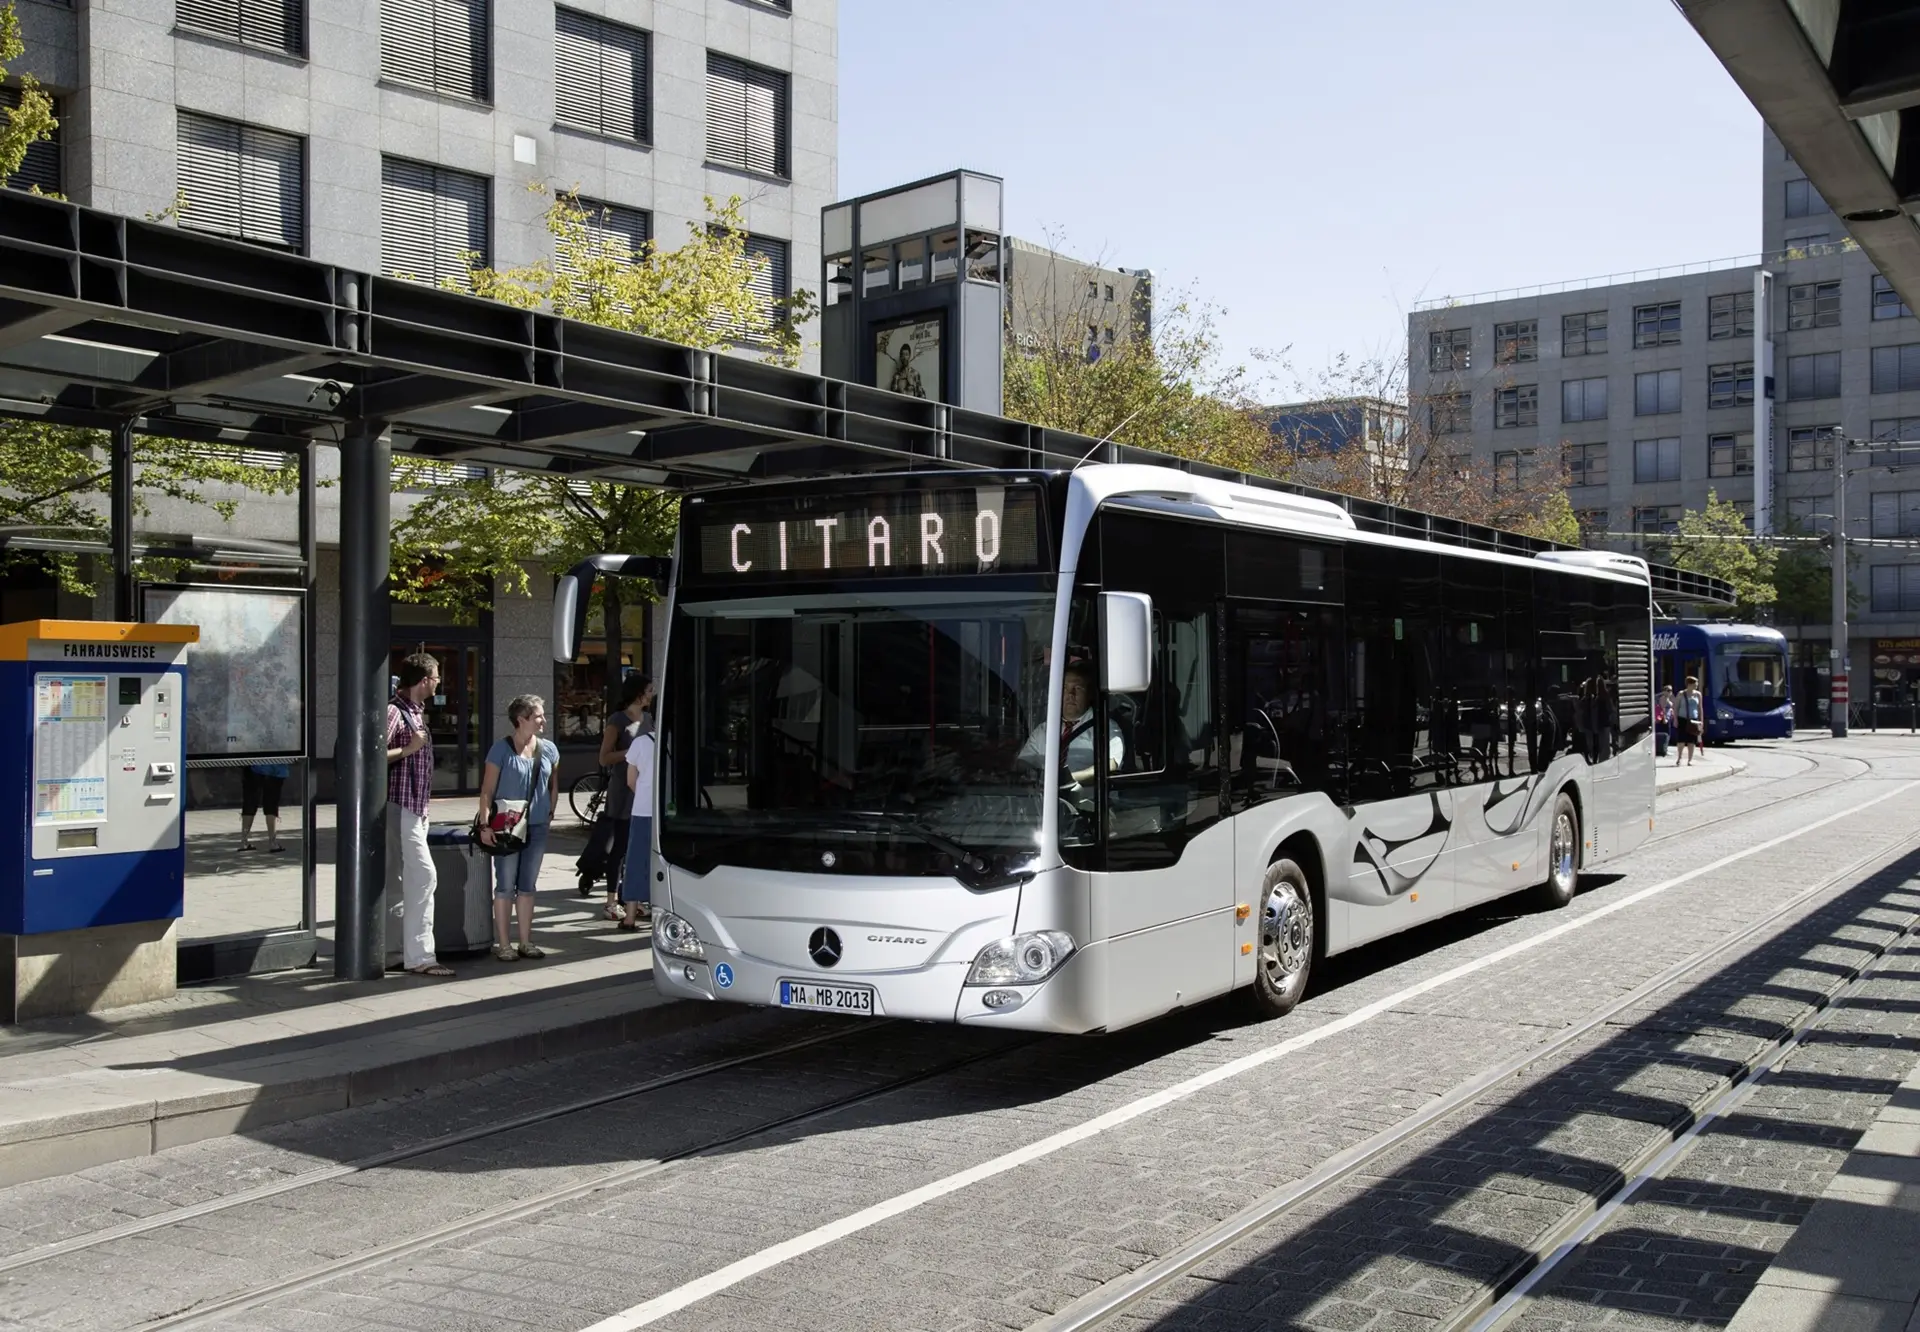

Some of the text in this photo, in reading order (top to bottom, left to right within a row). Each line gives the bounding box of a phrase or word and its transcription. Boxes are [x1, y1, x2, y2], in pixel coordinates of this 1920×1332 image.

[731, 510, 1000, 572] CITARO
[63, 643, 156, 659] FAHRAUSWEISE
[867, 935, 928, 945] CITARO
[790, 985, 869, 1009] MA MB 2013
